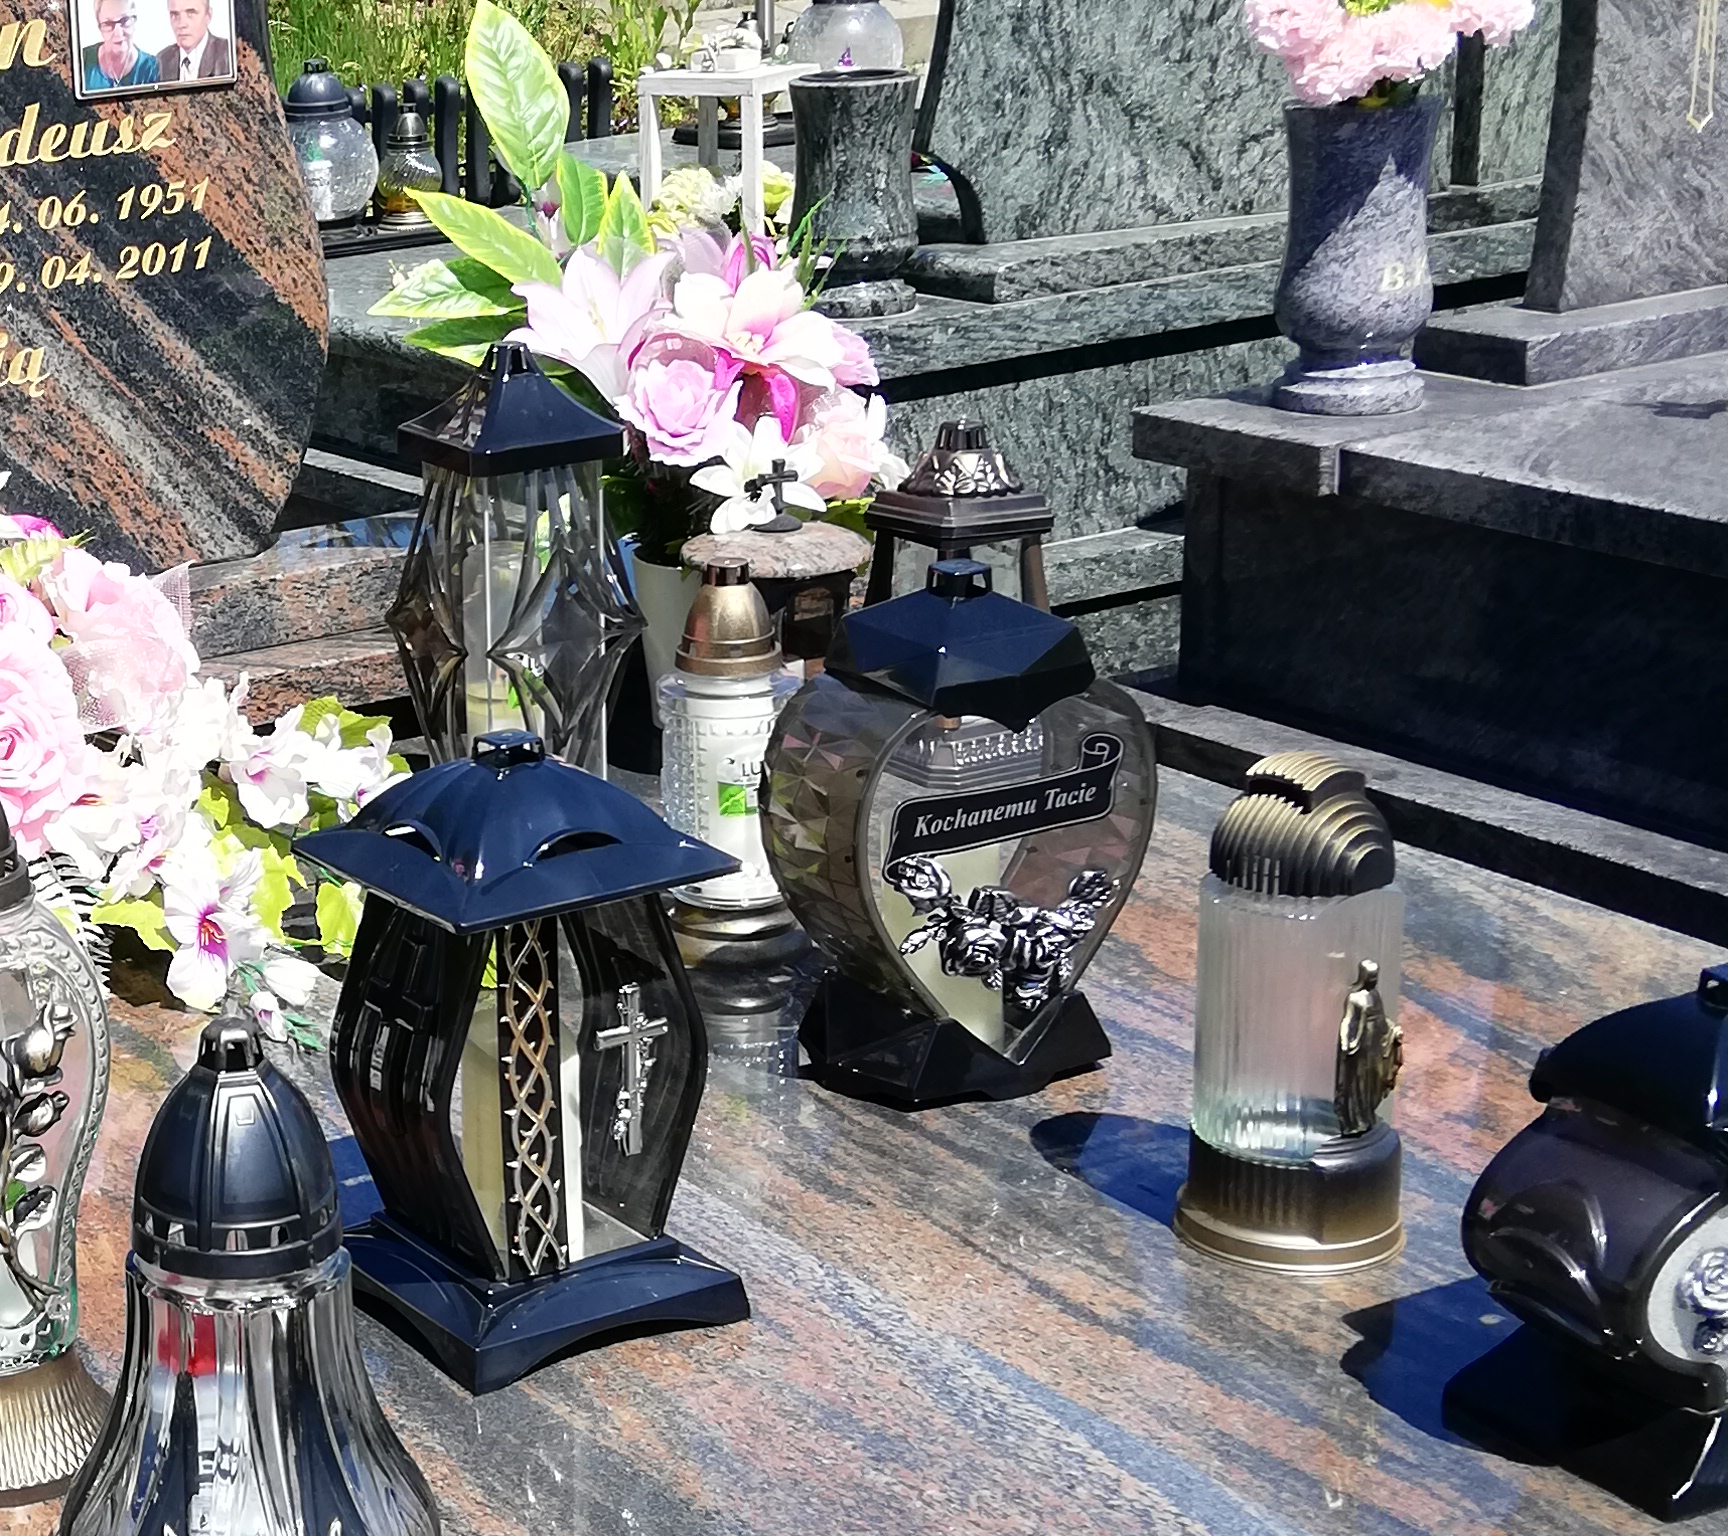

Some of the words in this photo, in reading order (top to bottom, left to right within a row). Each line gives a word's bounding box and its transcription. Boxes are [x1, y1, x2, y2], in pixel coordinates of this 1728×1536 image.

[37, 189, 100, 230] 06.
[116, 177, 210, 220] 1951
[41, 251, 103, 290] 04.
[115, 236, 213, 280] 2011
[913, 798, 1038, 838] Kochanemu
[1043, 782, 1098, 811] Tacie
